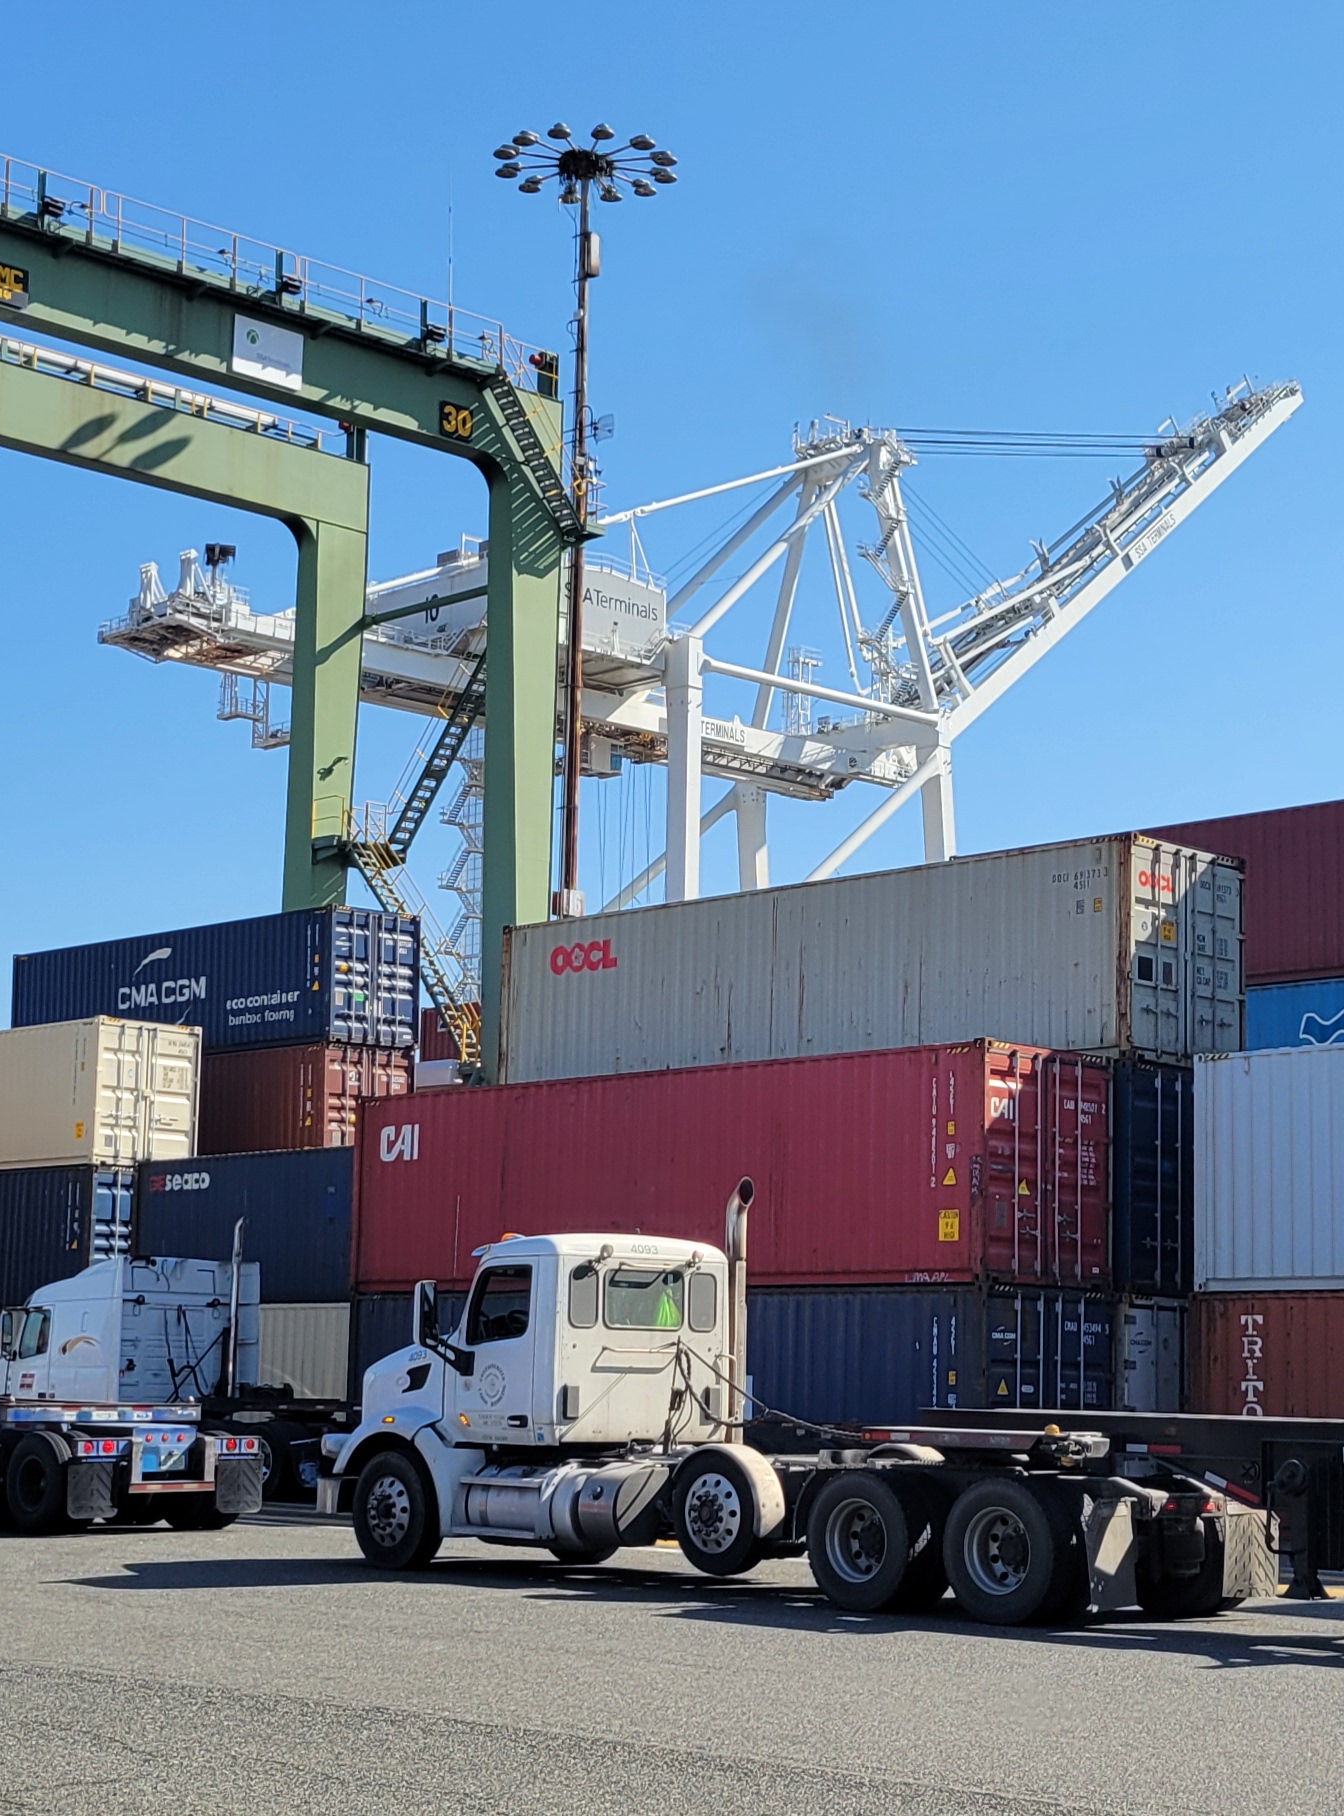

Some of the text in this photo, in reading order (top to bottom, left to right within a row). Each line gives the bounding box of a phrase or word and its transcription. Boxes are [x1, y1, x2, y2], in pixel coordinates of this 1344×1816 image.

[442, 405, 471, 437] 30
[550, 938, 618, 976] OOCL
[118, 975, 206, 1010] CMA CGM
[990, 1097, 1014, 1120] CAI
[380, 1123, 420, 1162] CAI
[630, 1243, 659, 1255] 4093
